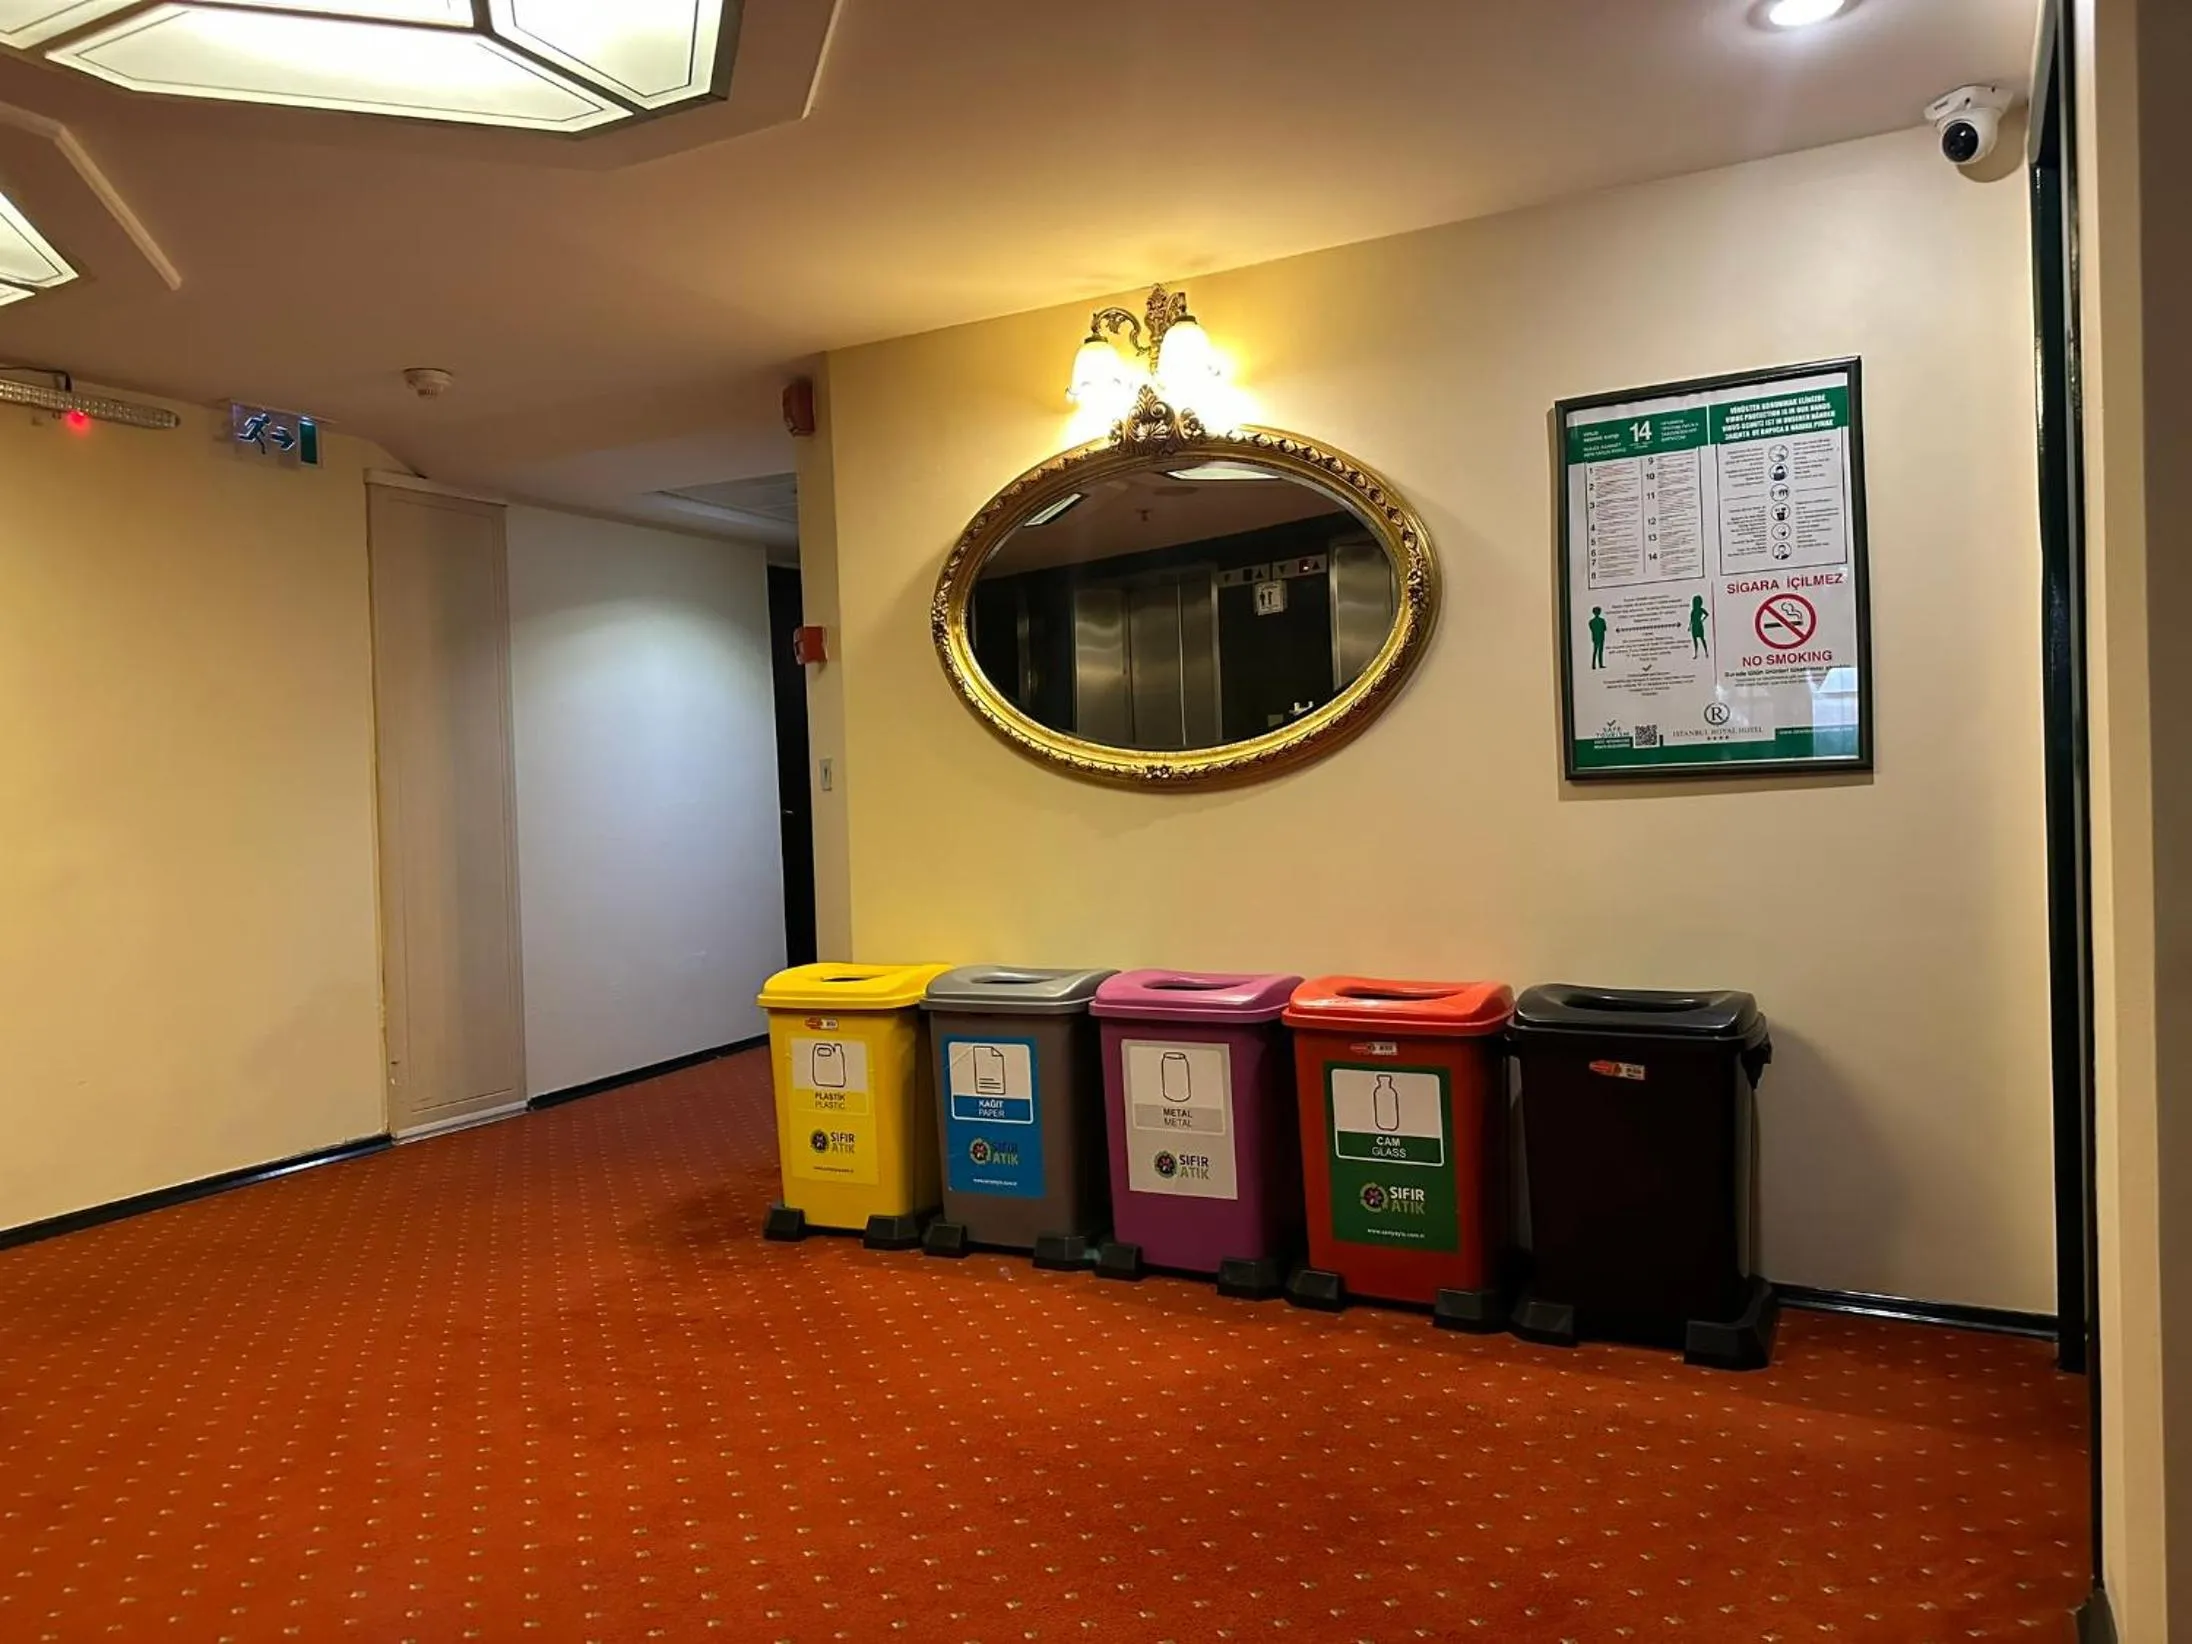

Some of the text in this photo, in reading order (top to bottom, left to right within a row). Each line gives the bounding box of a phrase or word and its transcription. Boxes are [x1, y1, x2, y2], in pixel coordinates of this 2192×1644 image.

[1629, 420, 1652, 442] 14
[1727, 573, 1843, 594] SİGARA İÇİLMEZ
[1742, 650, 1832, 667] NO SMOKING
[1711, 706, 1723, 721] R
[815, 1101, 845, 1109] PLASTIC
[979, 1099, 1004, 1109] KAĞIT
[979, 1109, 1005, 1118] PAPER
[1163, 1108, 1193, 1118] METAL
[1164, 1118, 1192, 1127] METAL
[830, 1132, 855, 1143] SIFIR
[1376, 1136, 1401, 1147] CAM
[831, 1143, 855, 1154] ATIK
[1371, 1146, 1407, 1158] GLASS
[992, 1153, 1018, 1165] ATIK
[1179, 1154, 1209, 1167] SIFIR
[1180, 1166, 1210, 1179] ATIK
[1389, 1186, 1425, 1201] SIFIR
[1391, 1200, 1425, 1215] ATIK
